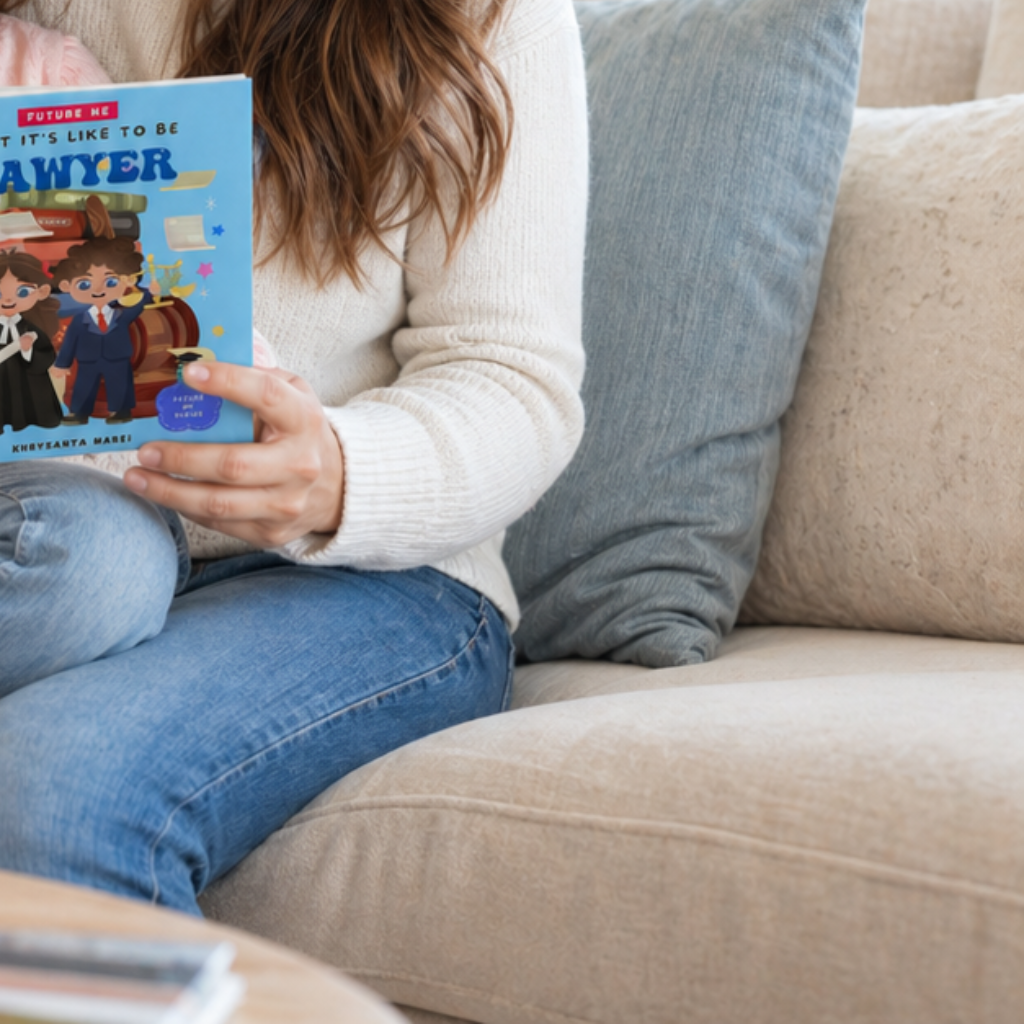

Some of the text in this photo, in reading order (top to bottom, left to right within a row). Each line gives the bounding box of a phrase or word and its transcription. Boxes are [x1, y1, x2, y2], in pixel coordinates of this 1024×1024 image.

[26, 105, 110, 122] FUTURE ME
[21, 132, 57, 146] IT'S
[68, 127, 109, 142] LIKE
[120, 125, 146, 137] TO
[156, 122, 178, 135] BE
